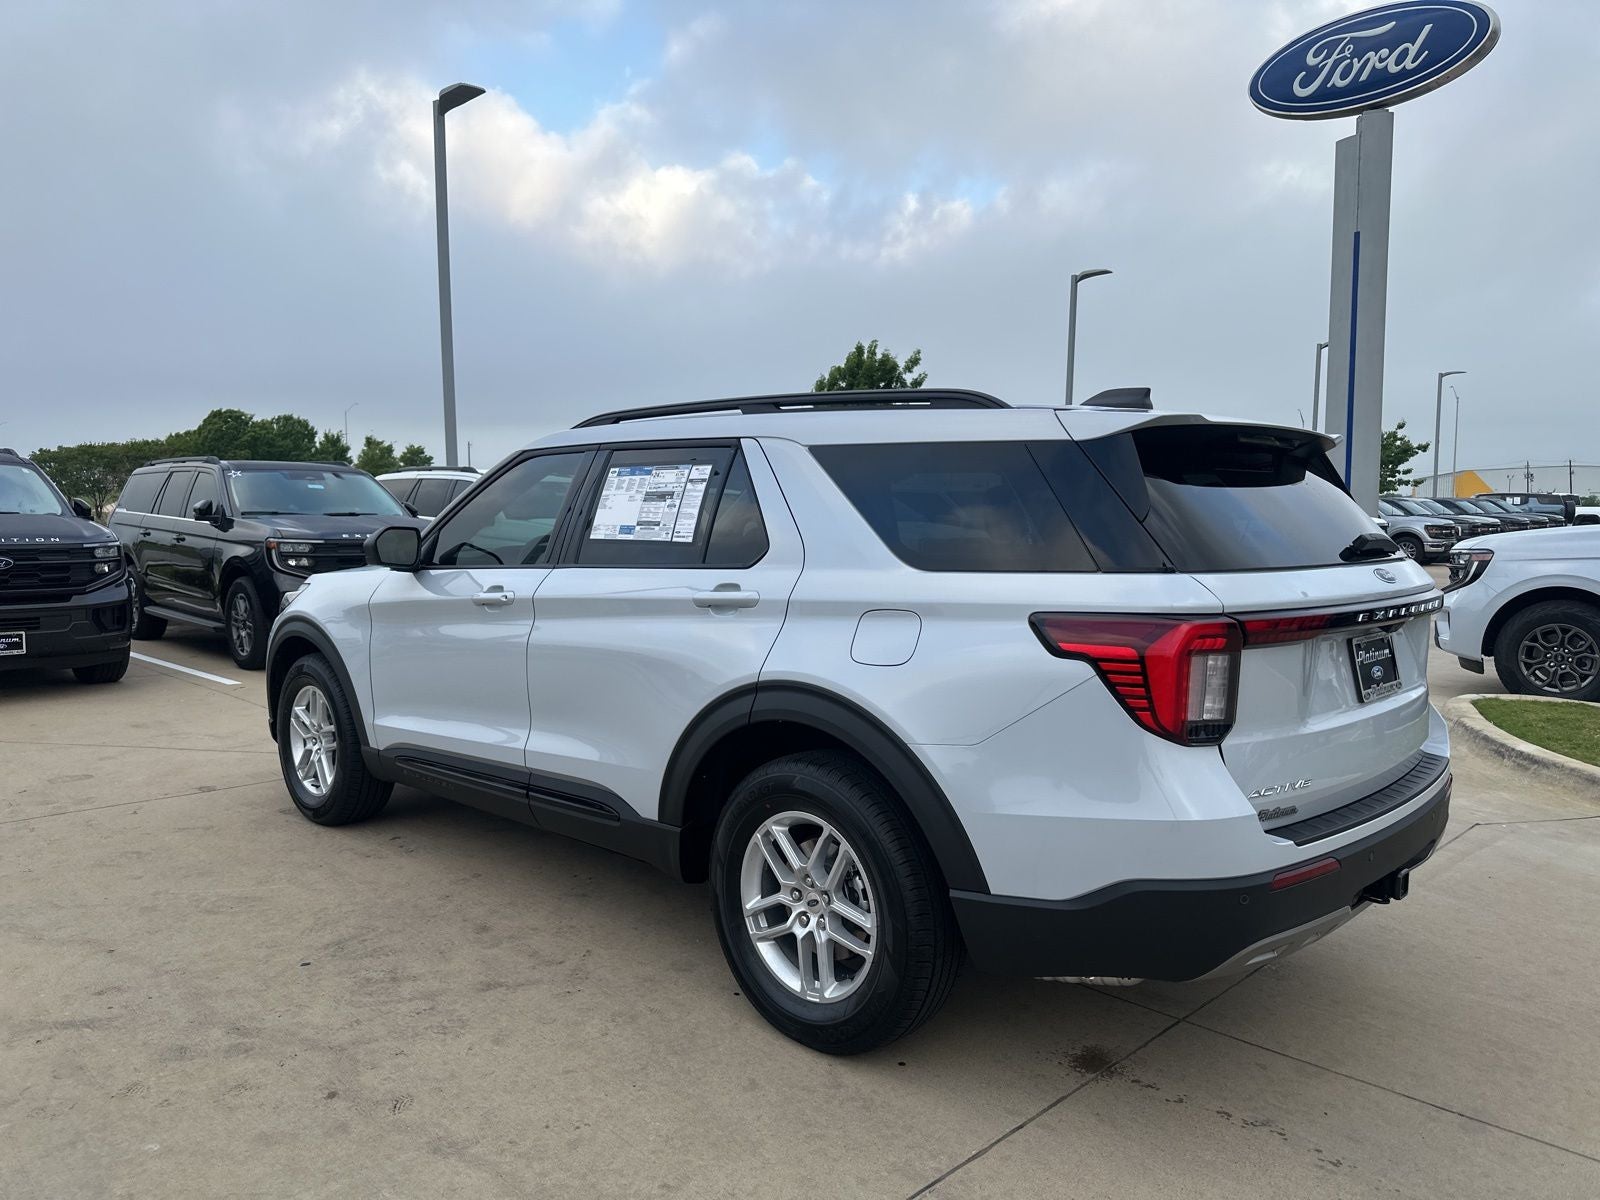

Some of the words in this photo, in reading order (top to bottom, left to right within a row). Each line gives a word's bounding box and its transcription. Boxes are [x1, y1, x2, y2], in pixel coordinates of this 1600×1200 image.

[1292, 21, 1433, 97] Ford
[1357, 648, 1391, 665] Platinum
[1247, 779, 1312, 799] ACTIVE
